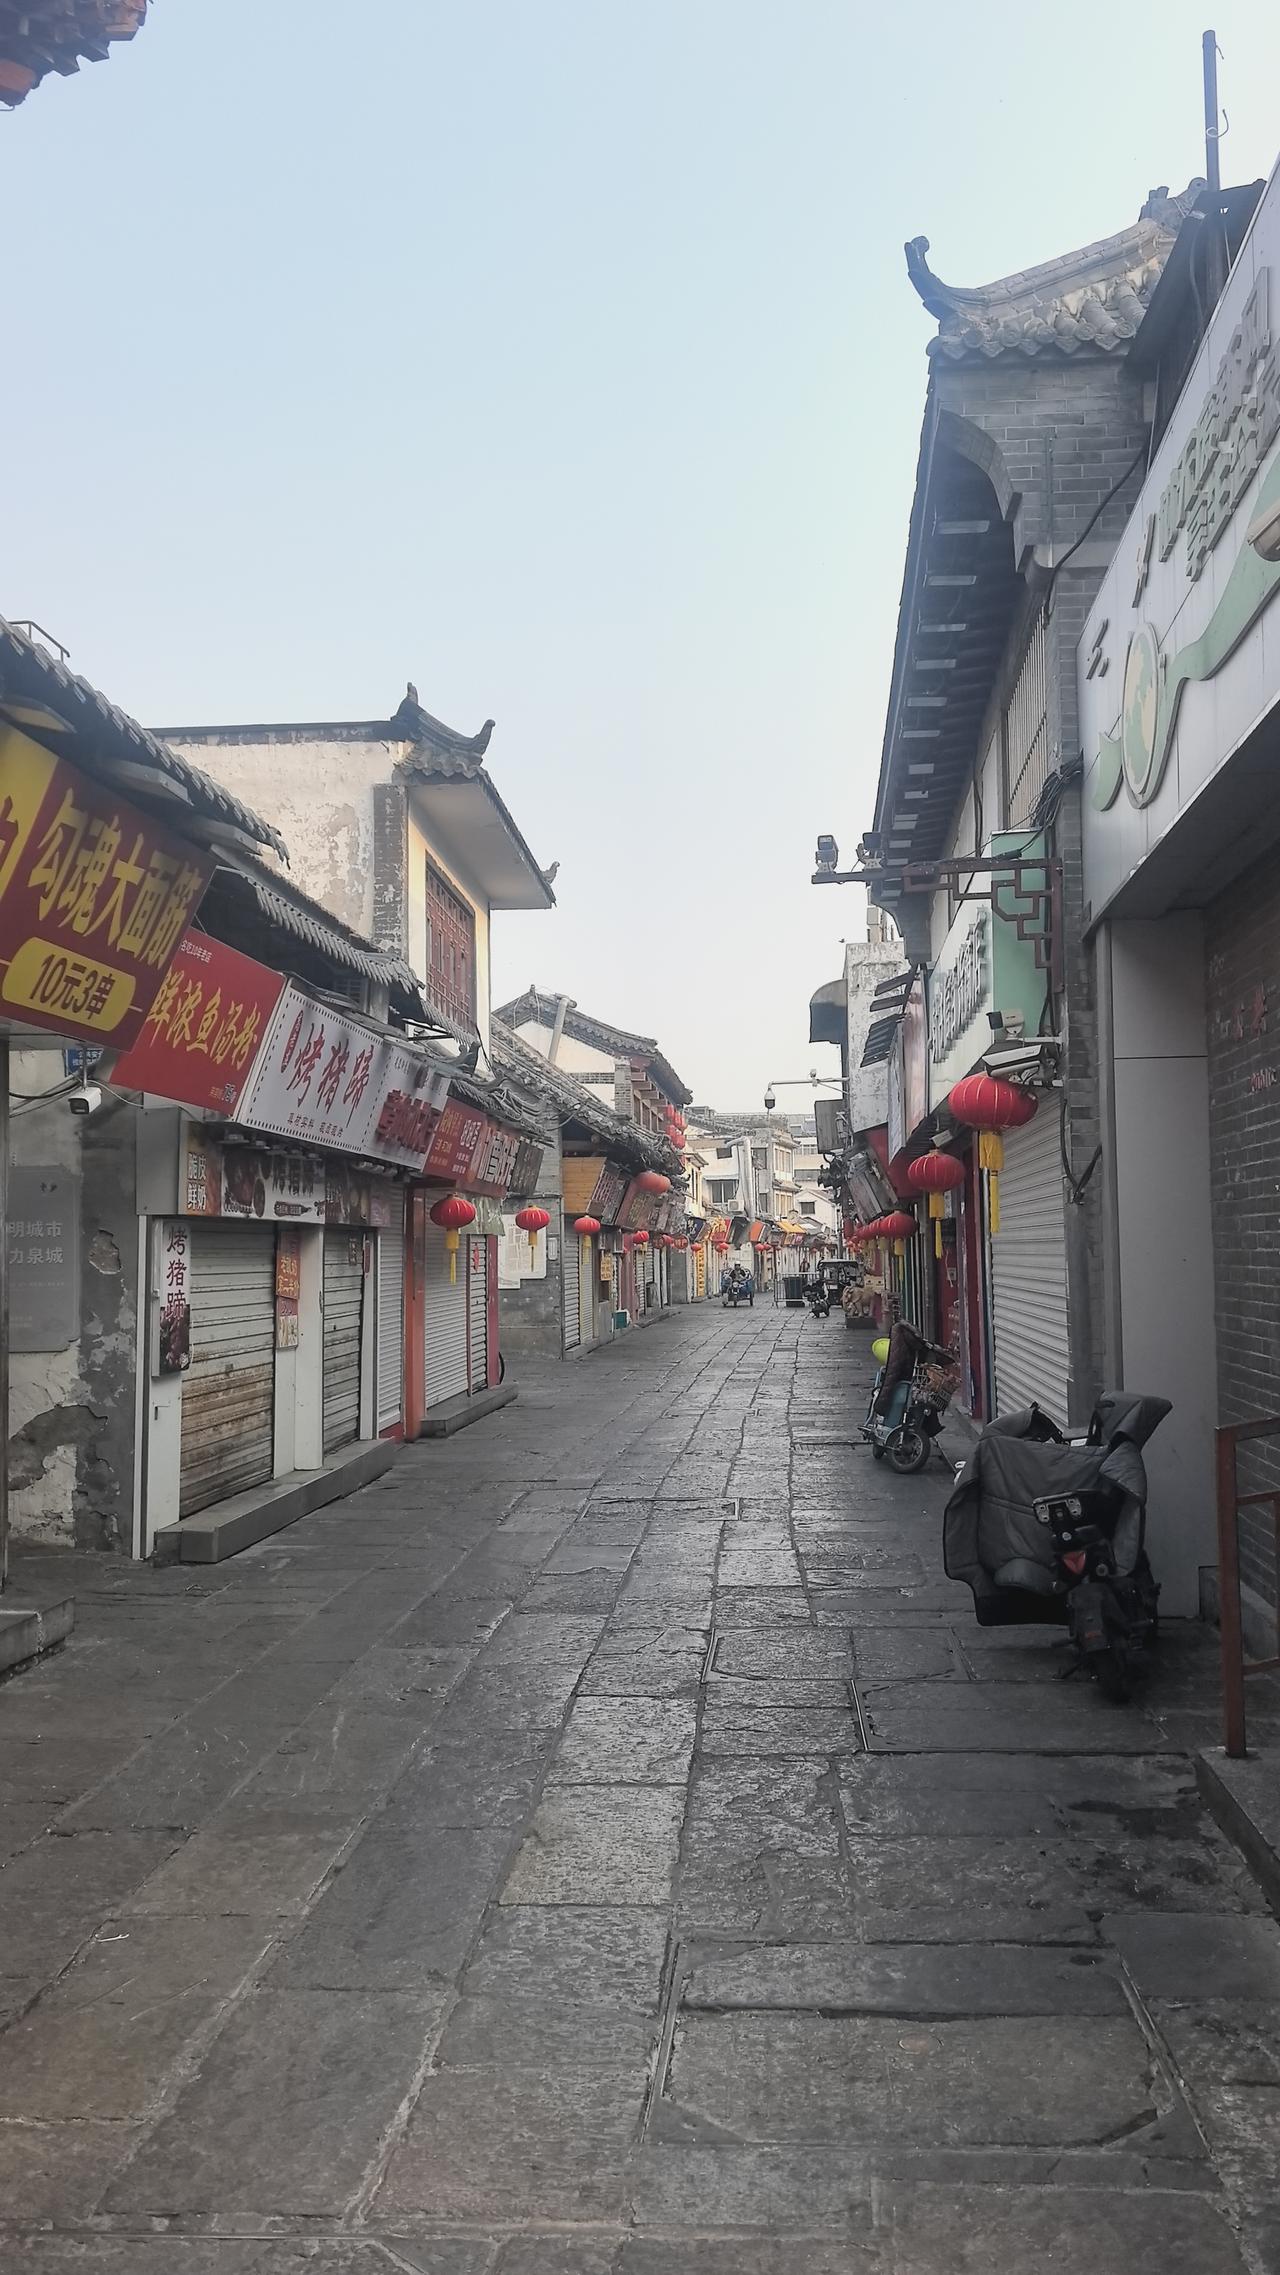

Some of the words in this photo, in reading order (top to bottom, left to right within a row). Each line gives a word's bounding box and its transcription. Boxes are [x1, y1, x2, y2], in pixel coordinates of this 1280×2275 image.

[28, 787, 204, 970] 勾魂大面筋
[30, 953, 115, 1020] 10元3串
[286, 1023, 374, 1128] 烤猪蹄
[166, 1226, 188, 1320] 烤猪蹄
